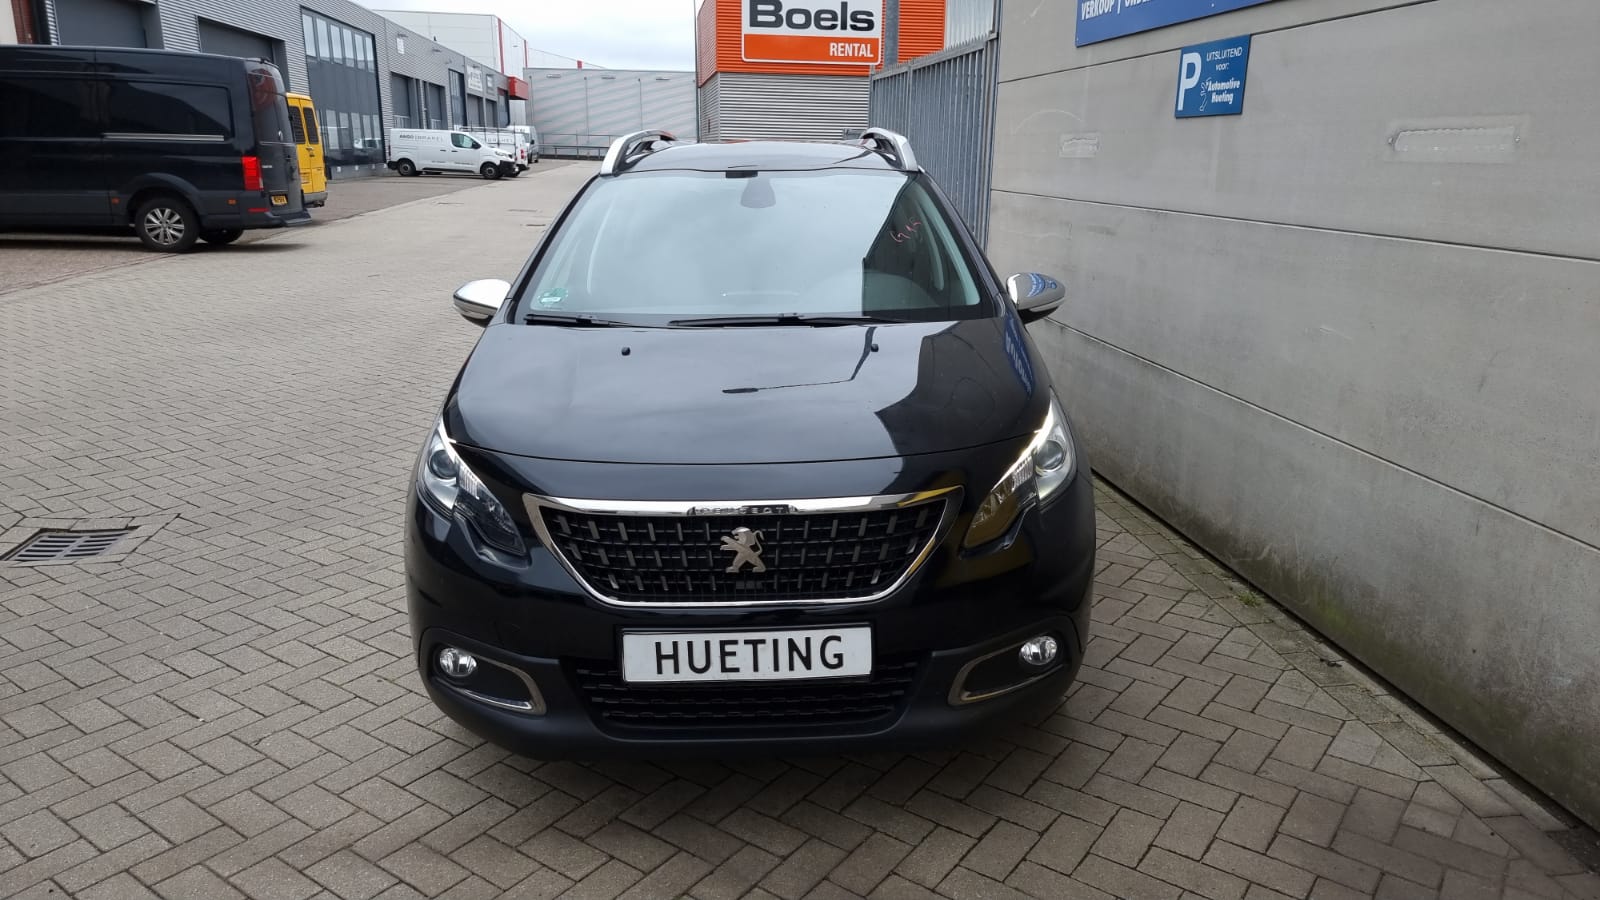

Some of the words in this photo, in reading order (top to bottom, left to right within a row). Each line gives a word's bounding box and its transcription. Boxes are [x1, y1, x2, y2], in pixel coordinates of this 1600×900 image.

[749, 0, 875, 31] Boels
[829, 42, 874, 57] RENTAL
[1206, 46, 1243, 62] UITSLUITEND
[1177, 52, 1202, 111] P
[1207, 77, 1241, 92] Automotive
[1211, 91, 1234, 105] Hueting
[655, 635, 844, 675] HUETING
